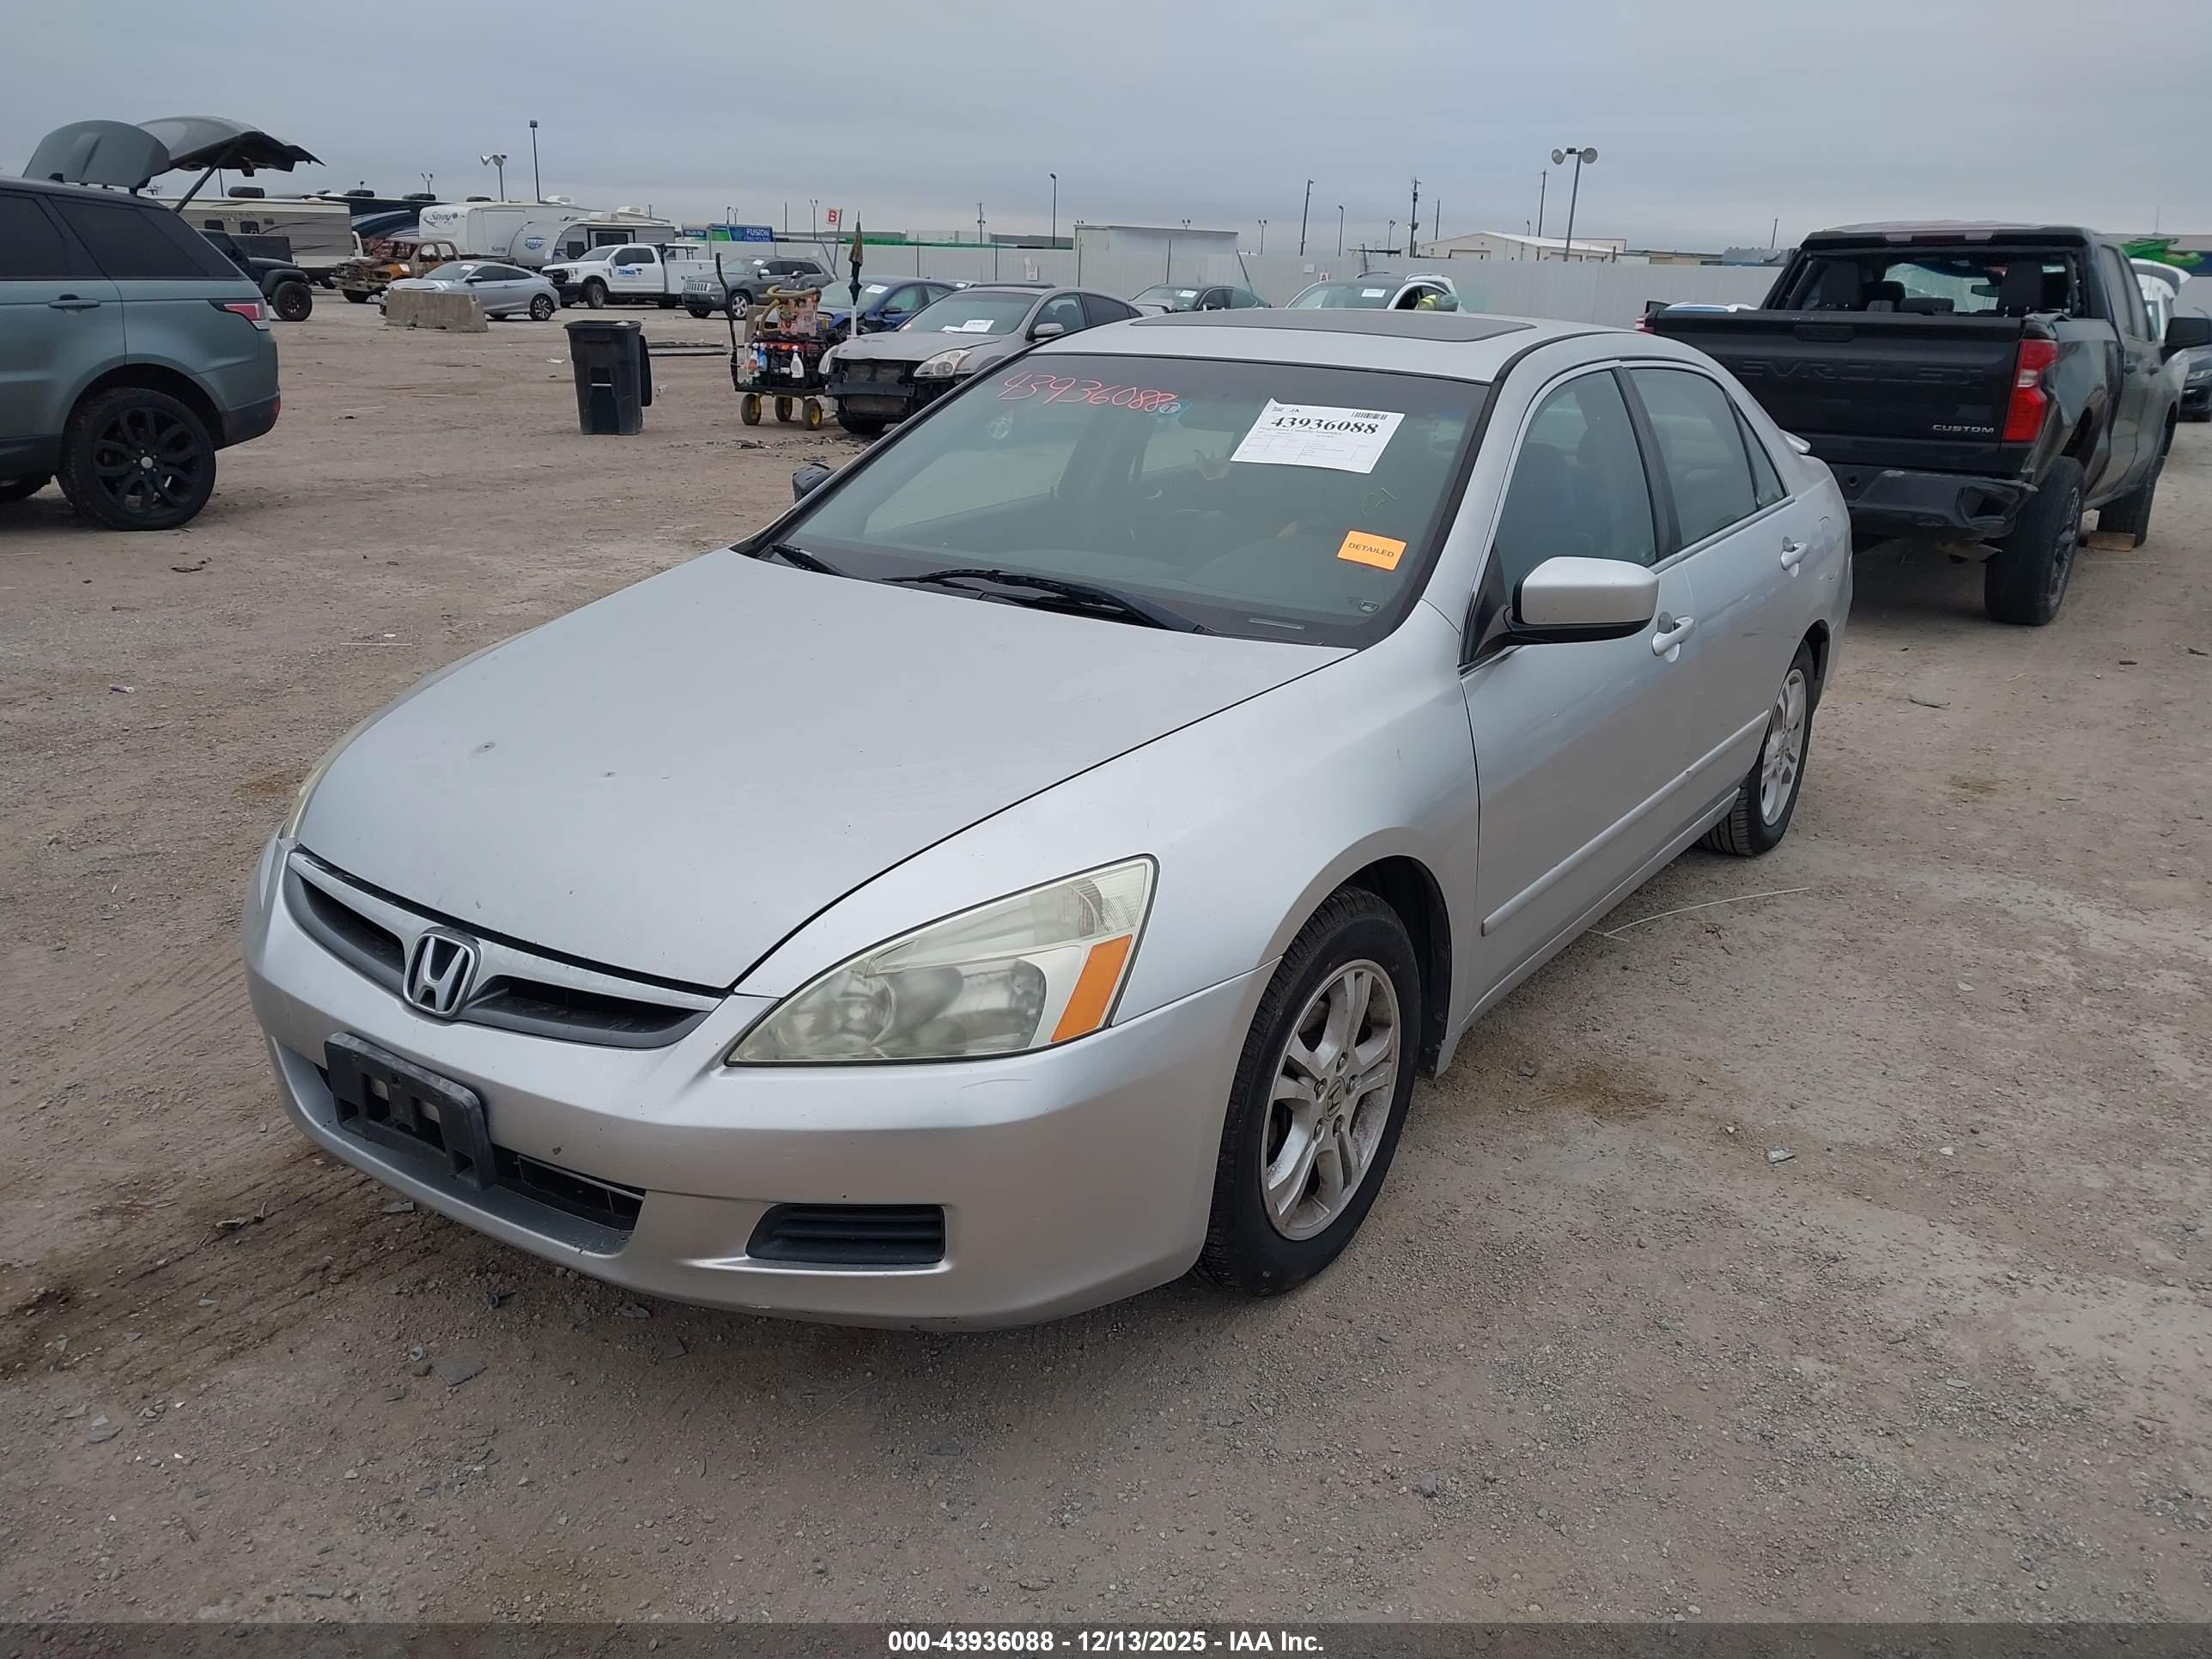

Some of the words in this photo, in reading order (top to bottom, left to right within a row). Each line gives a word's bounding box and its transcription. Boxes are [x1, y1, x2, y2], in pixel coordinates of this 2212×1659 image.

[829, 210, 836, 222] B
[998, 371, 1178, 412] 43936088
[1271, 416, 1379, 434] 43936088
[1932, 424, 1995, 434] CUSTOM
[1348, 542, 1395, 557] DETAILED
